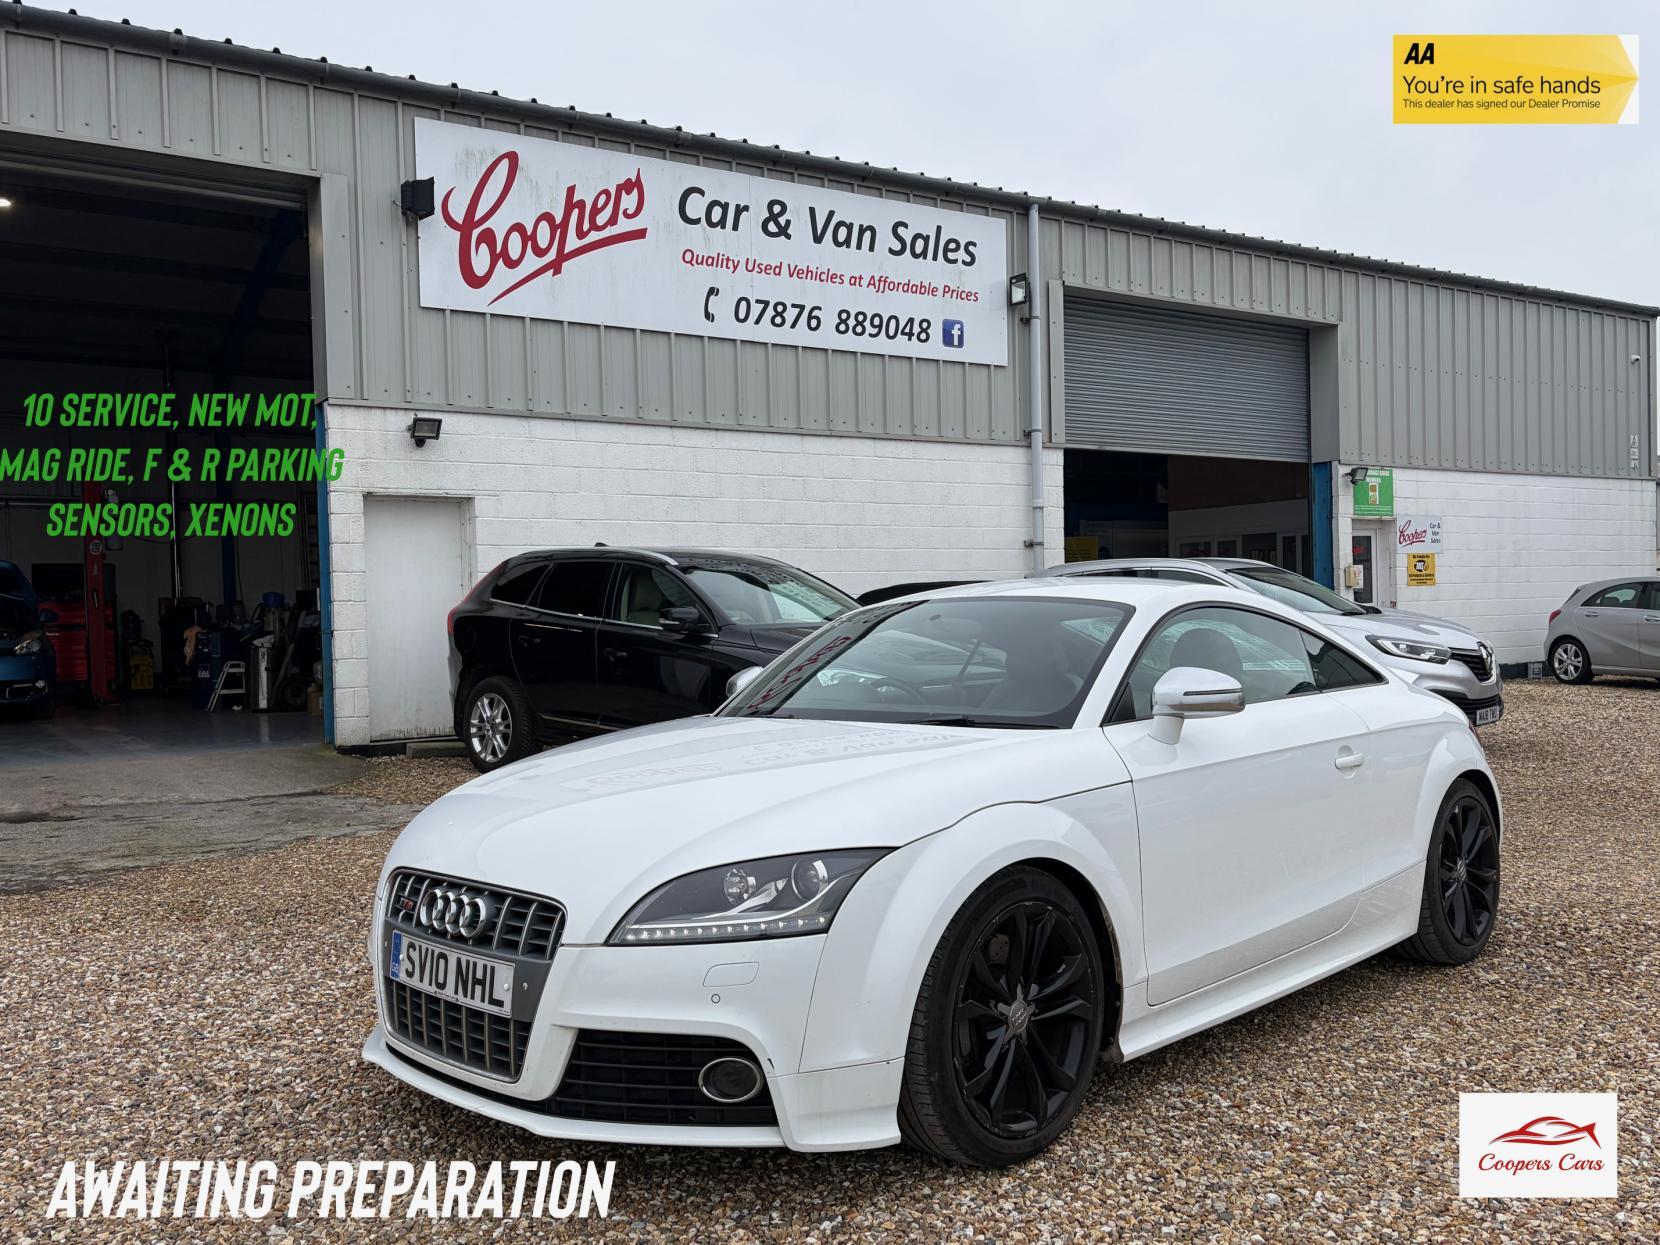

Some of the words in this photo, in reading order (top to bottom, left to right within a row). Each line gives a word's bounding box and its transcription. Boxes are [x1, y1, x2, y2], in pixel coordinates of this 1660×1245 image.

[442, 151, 647, 296] Coopers
[679, 186, 749, 232] Car
[761, 199, 791, 240] &
[808, 206, 877, 252] Van
[888, 220, 977, 267] Sales
[682, 249, 740, 273] Quality
[745, 258, 782, 276] Used
[788, 263, 844, 285] Vehicles
[849, 275, 863, 287] at
[867, 275, 938, 297] Affordable
[943, 285, 979, 303] Prices
[734, 297, 823, 332] 07876
[835, 309, 932, 343] 889048
[405, 941, 449, 990] SV10
[454, 957, 504, 1008] NHL
